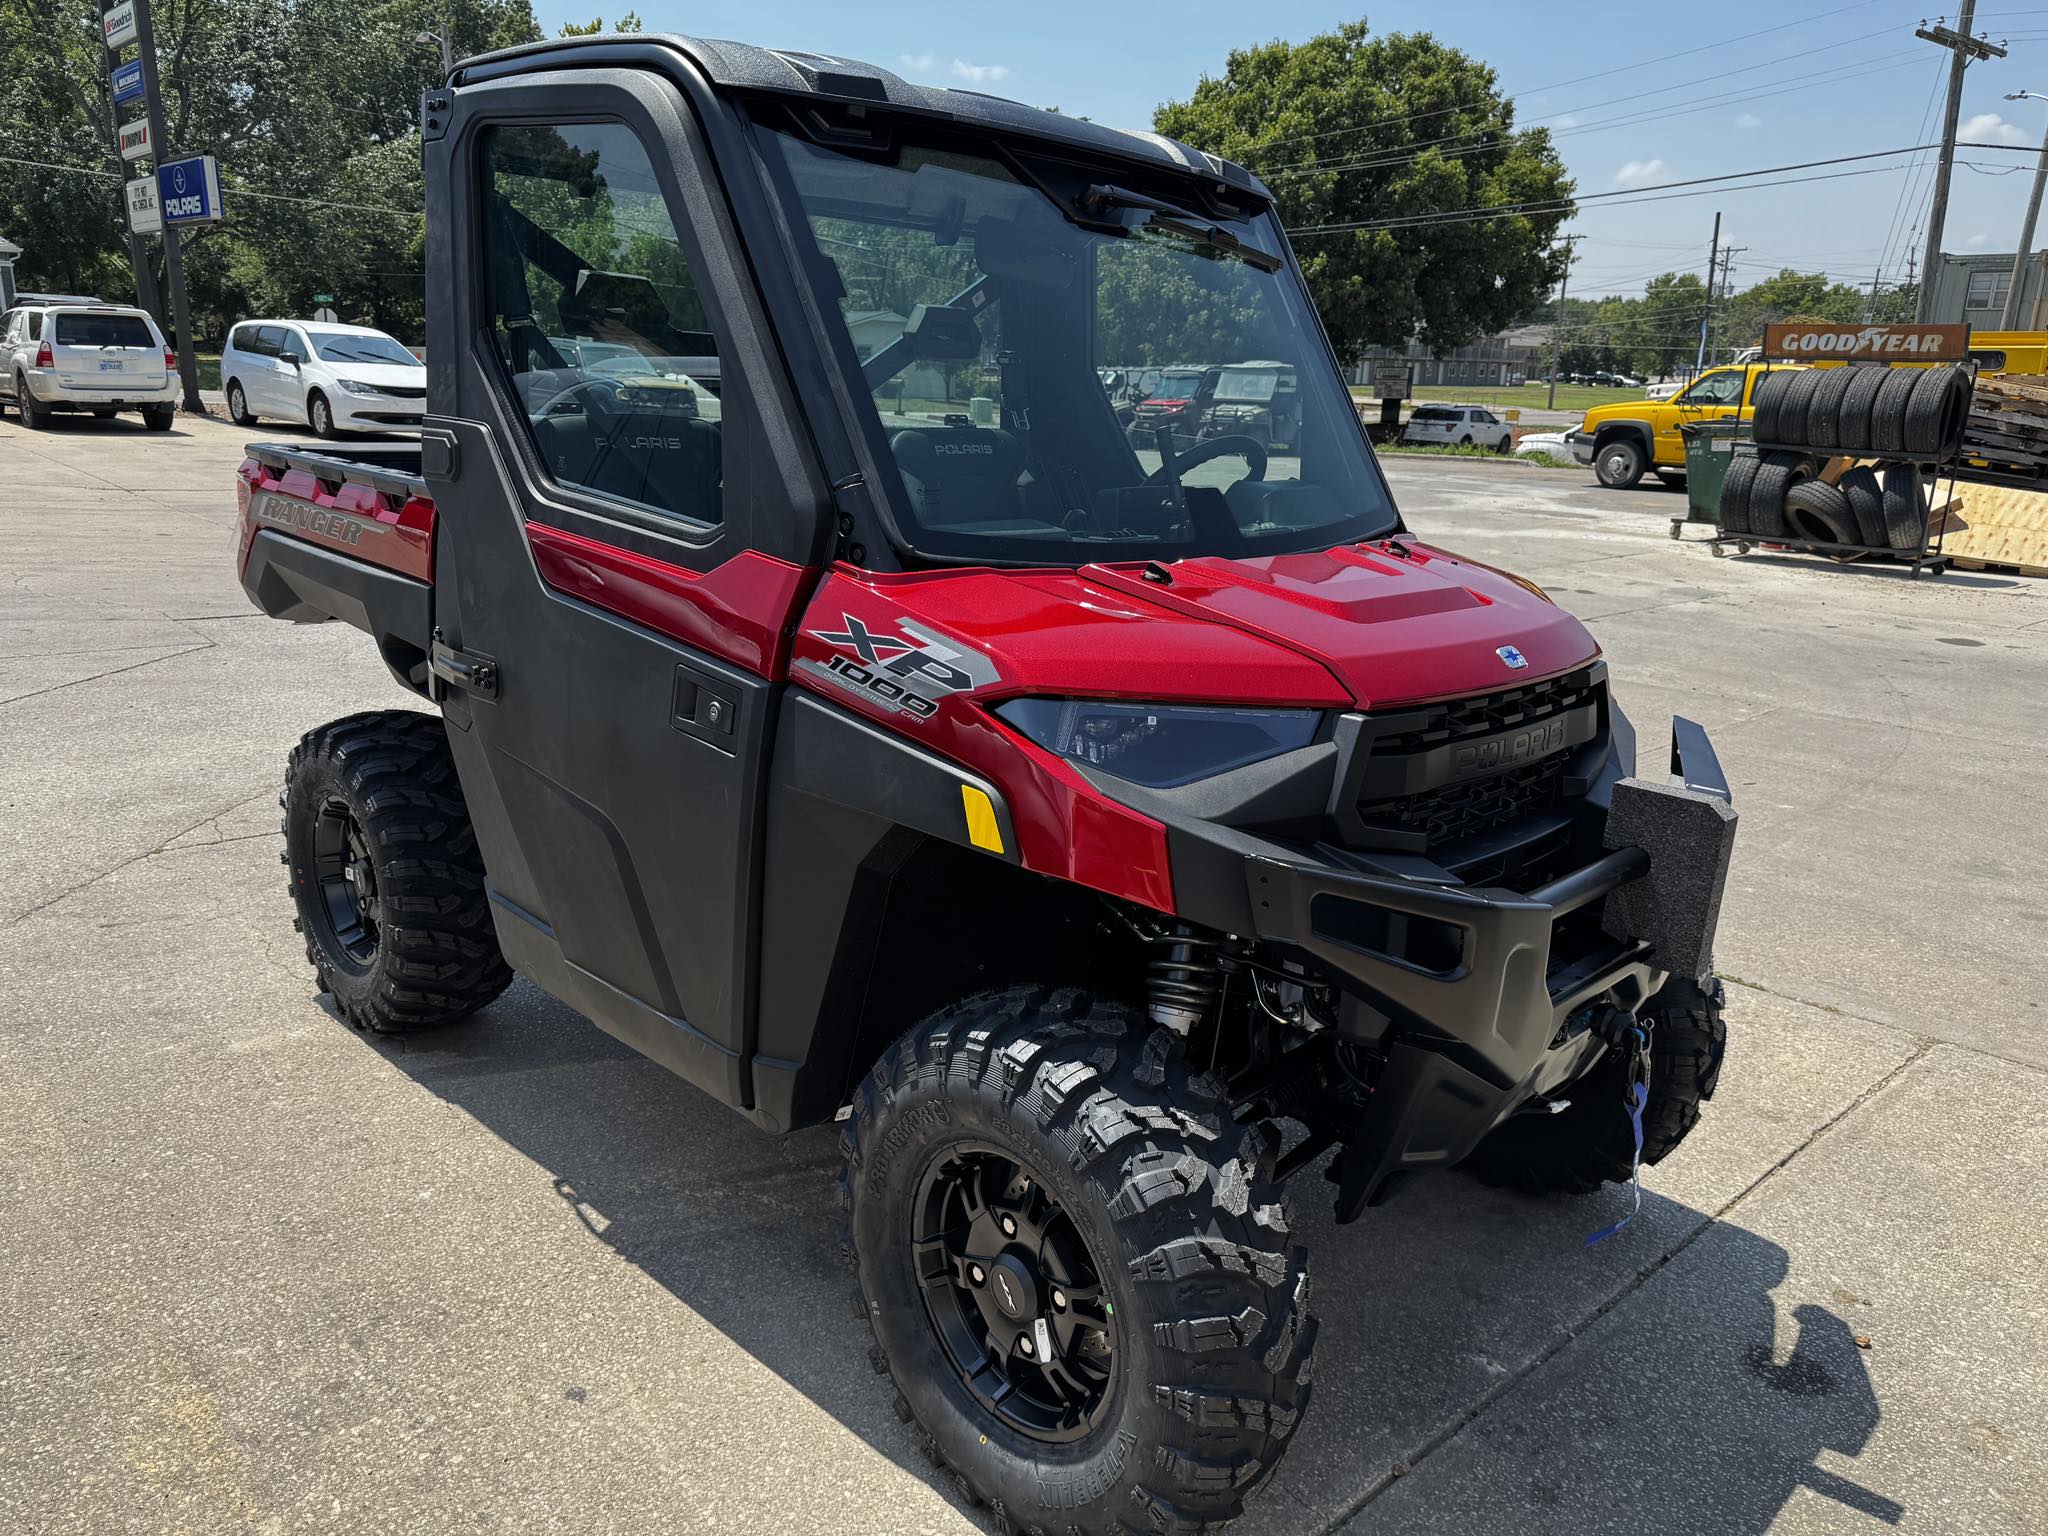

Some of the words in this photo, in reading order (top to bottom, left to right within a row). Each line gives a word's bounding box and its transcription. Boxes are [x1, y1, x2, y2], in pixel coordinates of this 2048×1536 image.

[165, 195, 202, 216] POLARIS
[1781, 328, 1944, 354] GOODYEAR
[934, 443, 993, 455] POLARIS
[262, 496, 364, 546] RANGER
[806, 612, 976, 692] XP
[822, 671, 847, 687] DUAL
[847, 683, 901, 712] OVERHEAD
[900, 710, 925, 725] CAM
[828, 654, 939, 717] 1000
[1457, 721, 1564, 769] POLARIS
